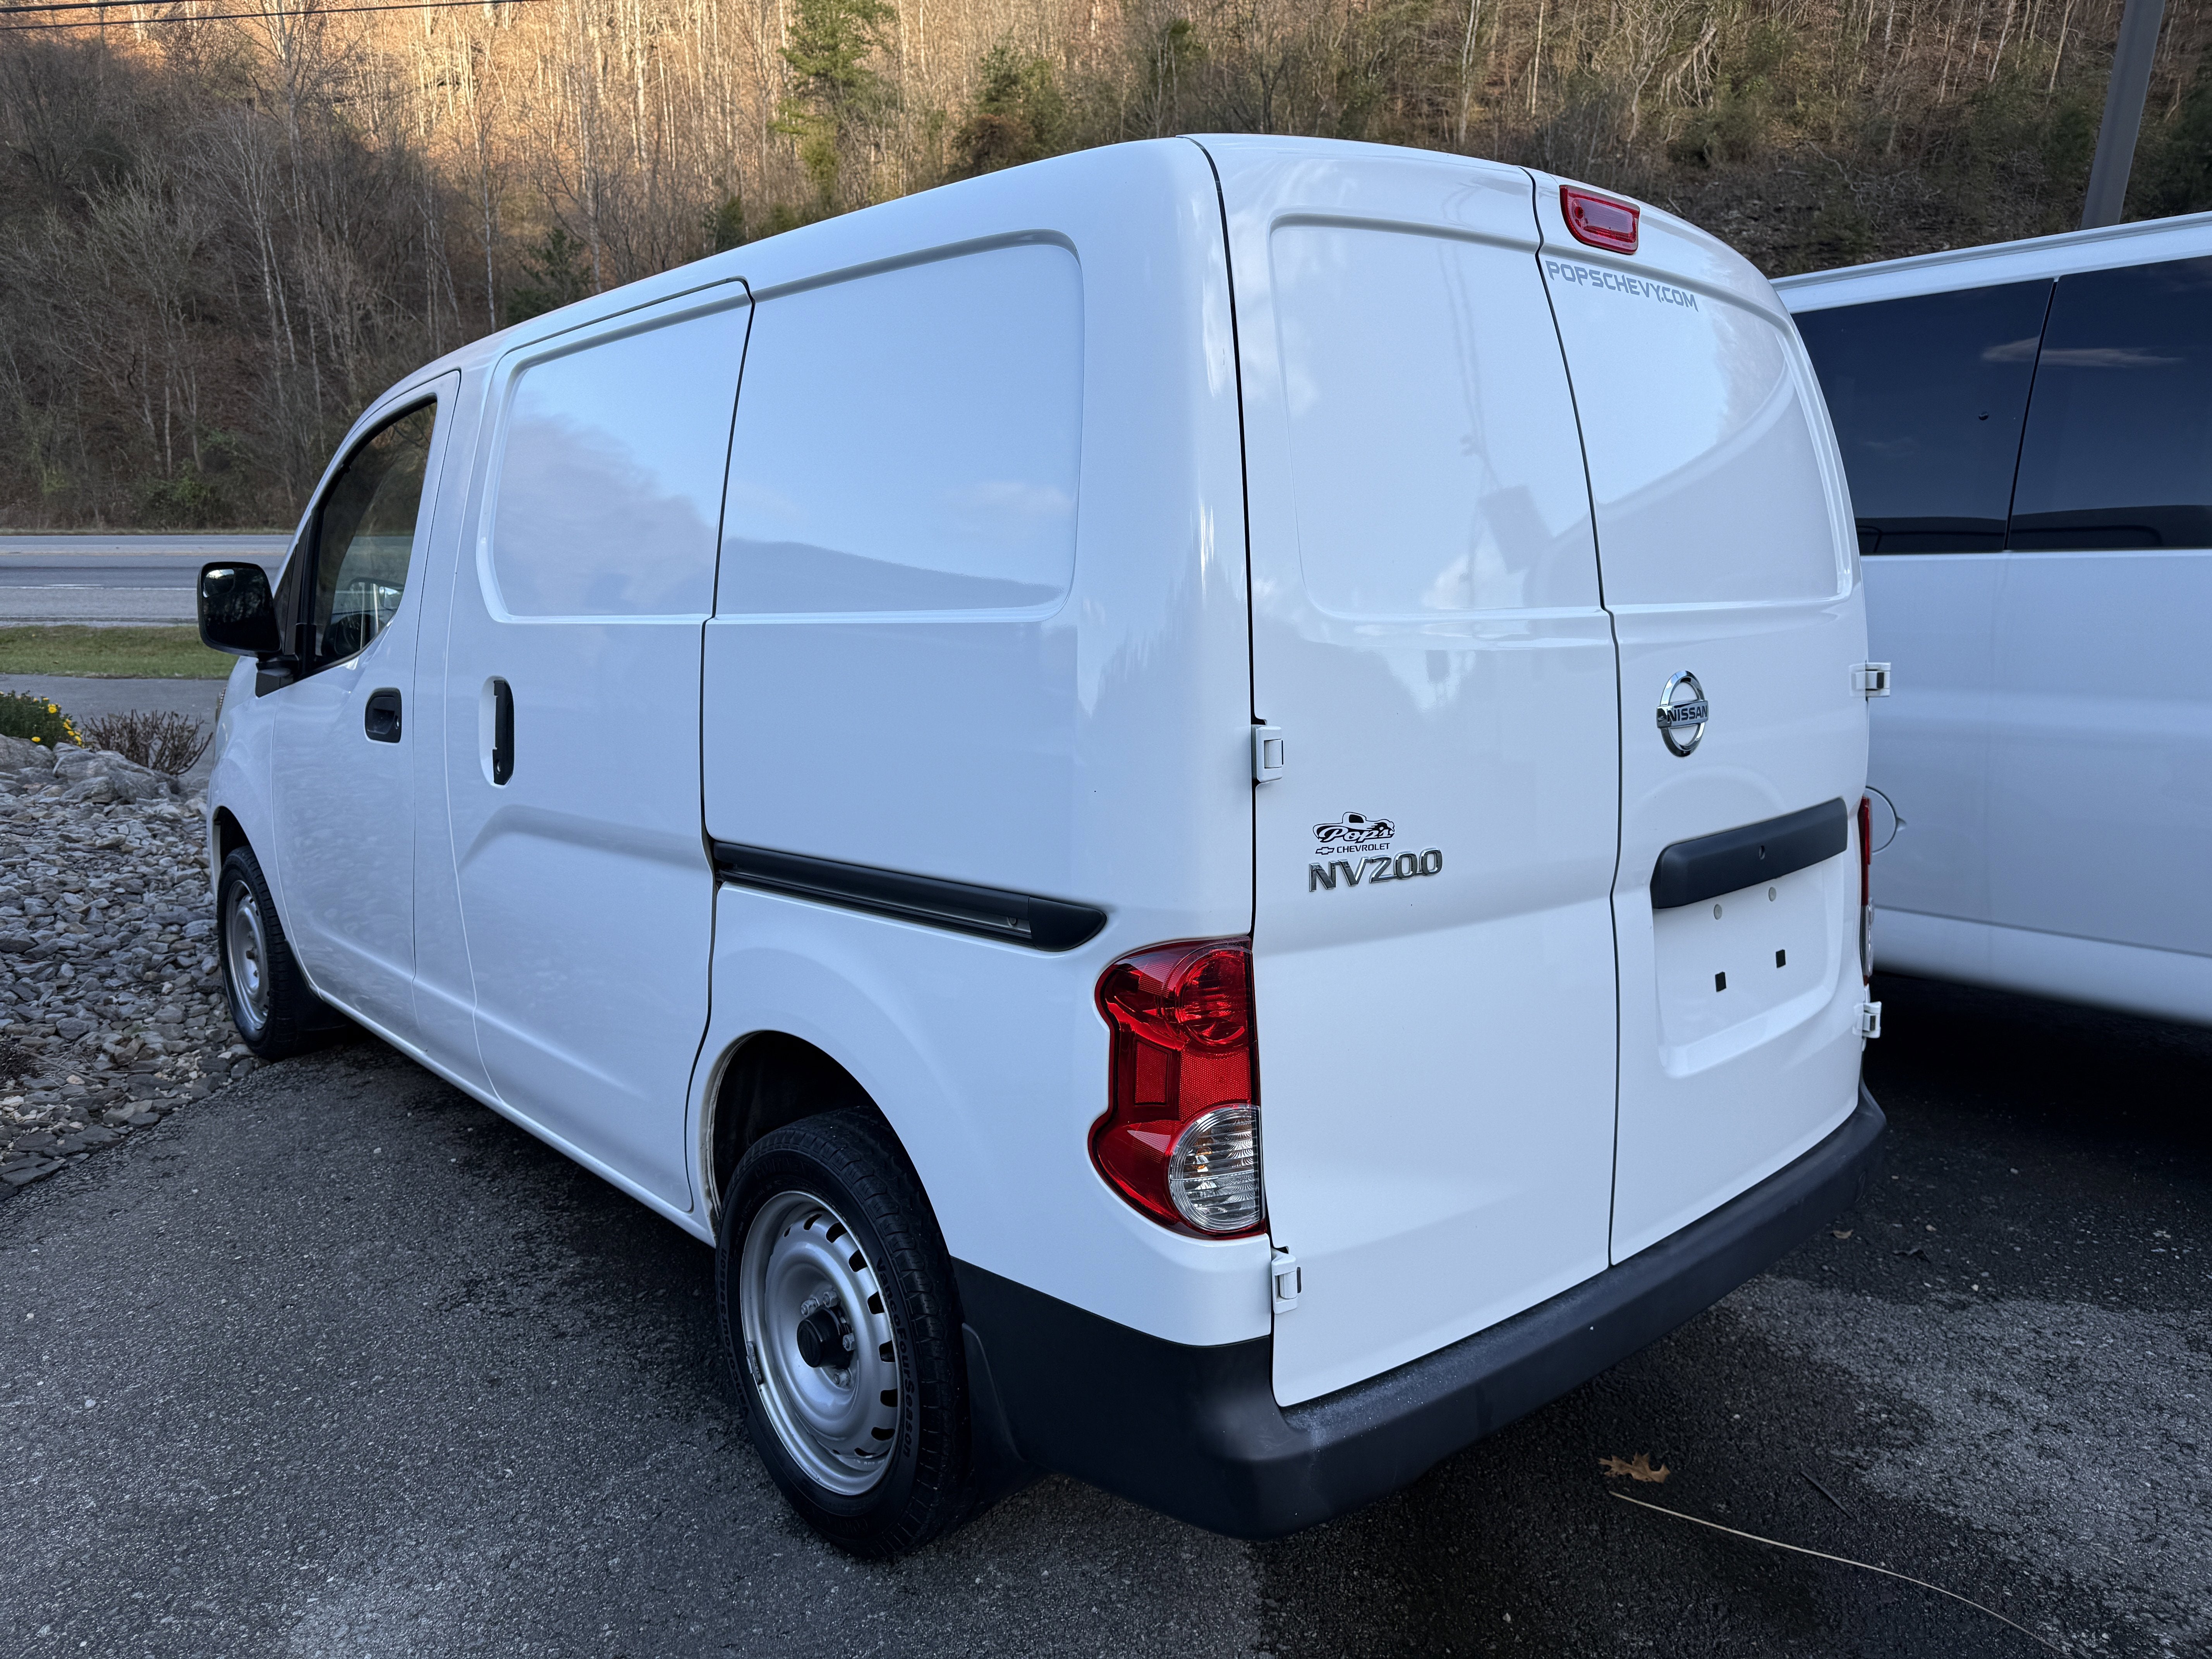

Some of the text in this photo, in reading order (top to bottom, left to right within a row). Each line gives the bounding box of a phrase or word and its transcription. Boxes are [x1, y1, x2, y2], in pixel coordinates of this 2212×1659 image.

[1545, 260, 1698, 312] POPSCHEVY.COM
[1667, 705, 1707, 721] NISSAN
[1309, 847, 1443, 892] NV200
[1337, 843, 1390, 853] CHEVROLET
[876, 1256, 915, 1458] VancoFourSeason
